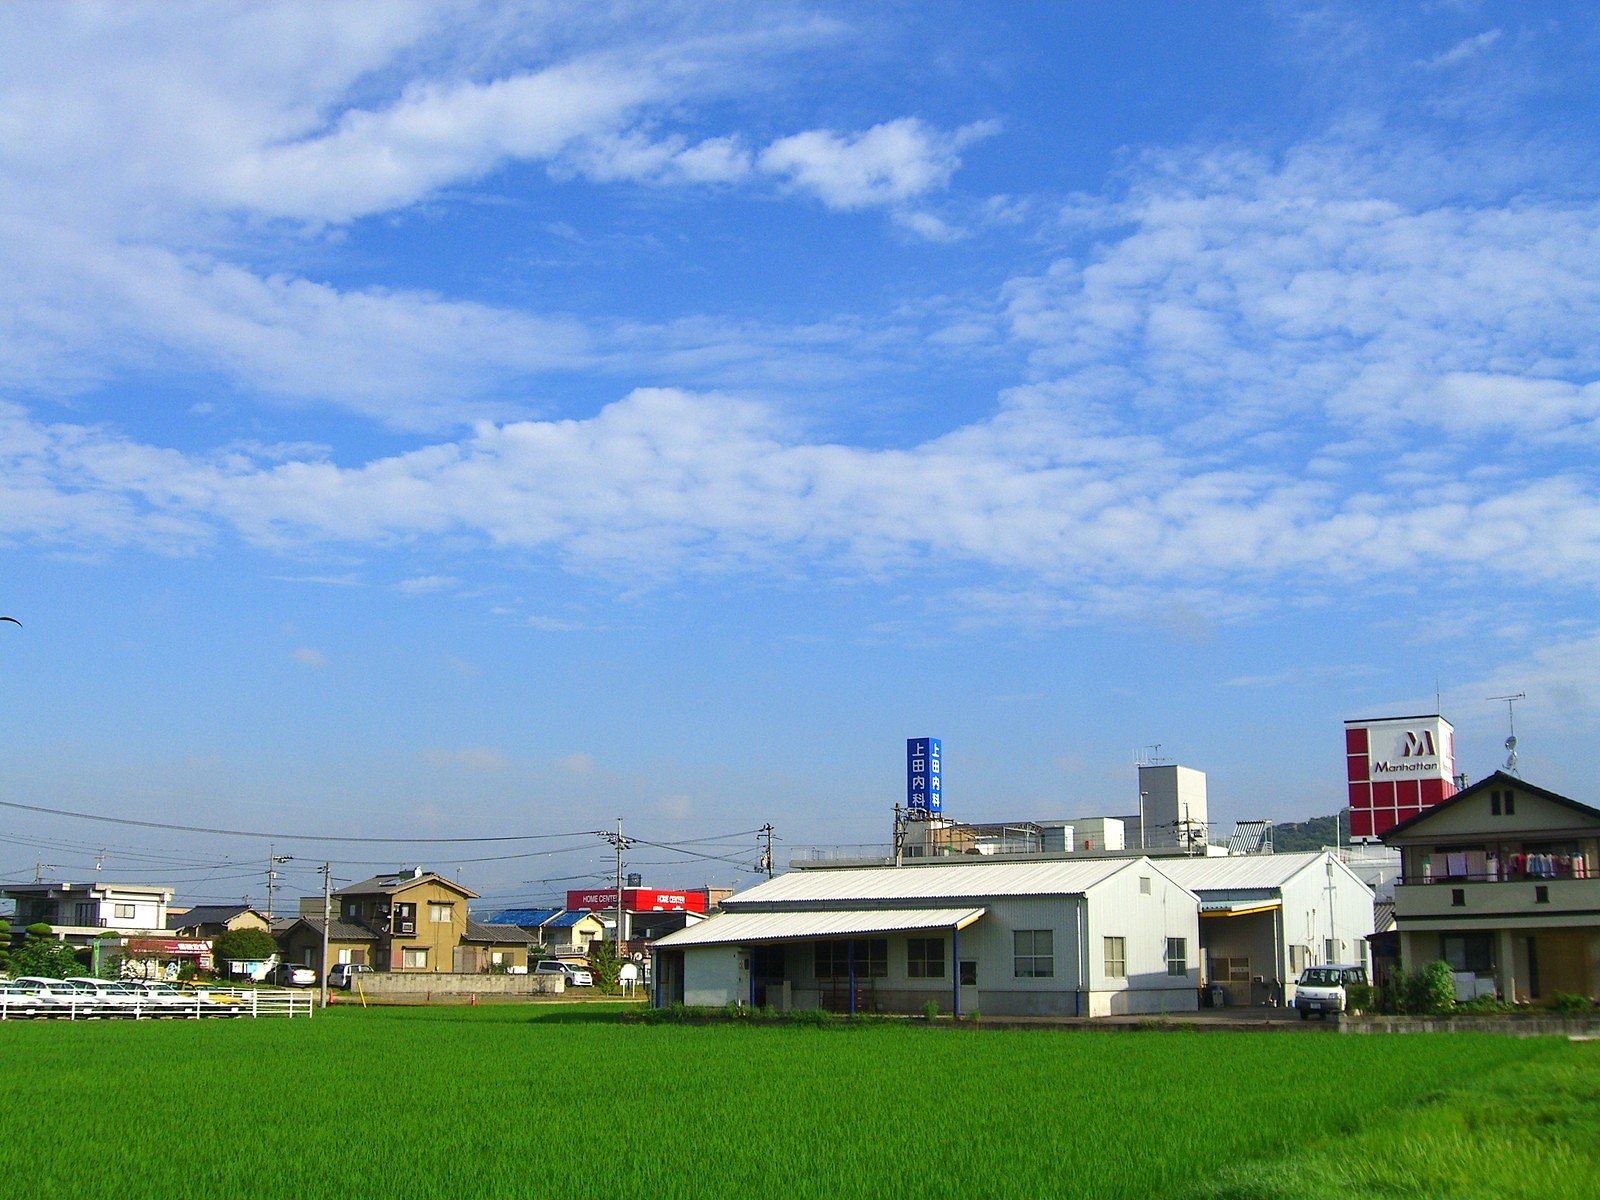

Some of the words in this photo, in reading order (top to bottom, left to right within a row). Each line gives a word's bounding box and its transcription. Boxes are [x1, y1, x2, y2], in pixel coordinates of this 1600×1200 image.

[1374, 760, 1439, 773] Manhattan
[912, 742, 926, 807] 上田内科
[931, 742, 940, 808] 上田内科
[582, 894, 599, 903] HOME
[599, 894, 619, 903] CENTE
[657, 894, 669, 904] HOME
[669, 895, 685, 904] CENTER
